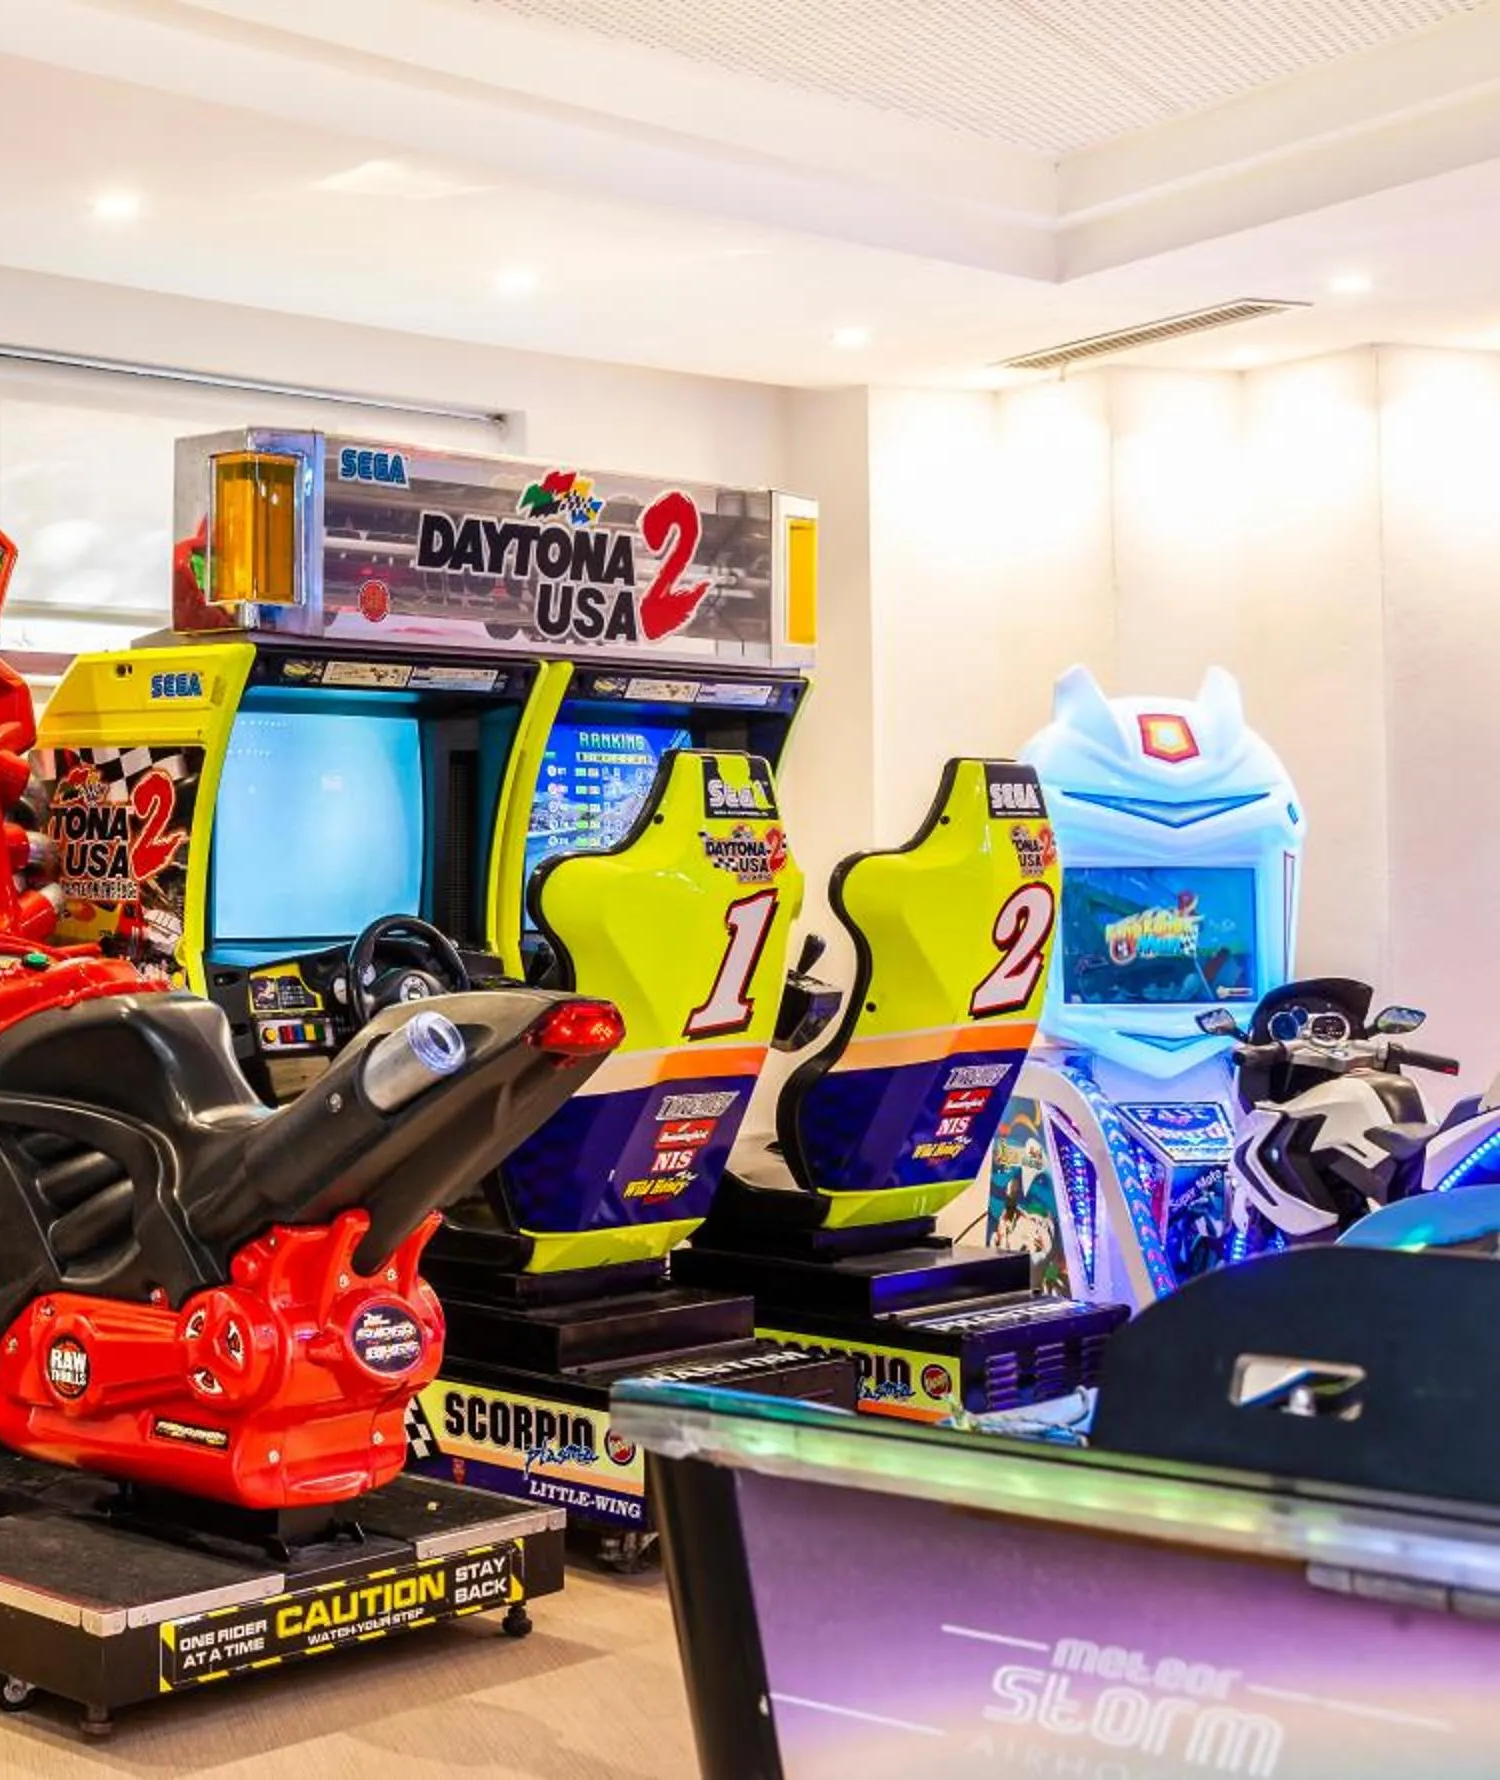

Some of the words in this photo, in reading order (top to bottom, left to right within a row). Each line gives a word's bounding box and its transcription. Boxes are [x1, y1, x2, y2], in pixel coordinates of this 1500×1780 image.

[340, 448, 409, 486] SEGA
[416, 511, 636, 587] DAYTONA
[635, 491, 711, 641] 2
[536, 583, 639, 641] USA
[151, 673, 203, 699] SEGA
[579, 731, 646, 751] RANKING
[989, 782, 1041, 809] SEGA
[50, 806, 130, 842] TONA
[131, 769, 187, 881] 2
[65, 844, 130, 879] USA
[705, 840, 767, 857] DAYTONA
[738, 858, 768, 873] USA
[1018, 853, 1042, 868] USA
[682, 888, 780, 1041] 1
[968, 881, 1056, 1020] 2
[652, 1150, 693, 1172] NIS
[51, 1347, 88, 1373] RAW
[444, 1390, 597, 1453] SCORPIO
[529, 1479, 642, 1520] LITTLE-WING
[453, 1556, 507, 1583] STAY
[275, 1570, 446, 1639] CAUTION
[453, 1576, 508, 1605] BACK
[179, 1631, 215, 1653] ONE
[217, 1619, 268, 1643] RIDER
[307, 1624, 354, 1646] WATCH
[355, 1614, 392, 1634] YOUR
[391, 1607, 426, 1625] STEP
[182, 1650, 207, 1670] AT
[209, 1647, 222, 1663] A
[223, 1637, 266, 1658] TIME
